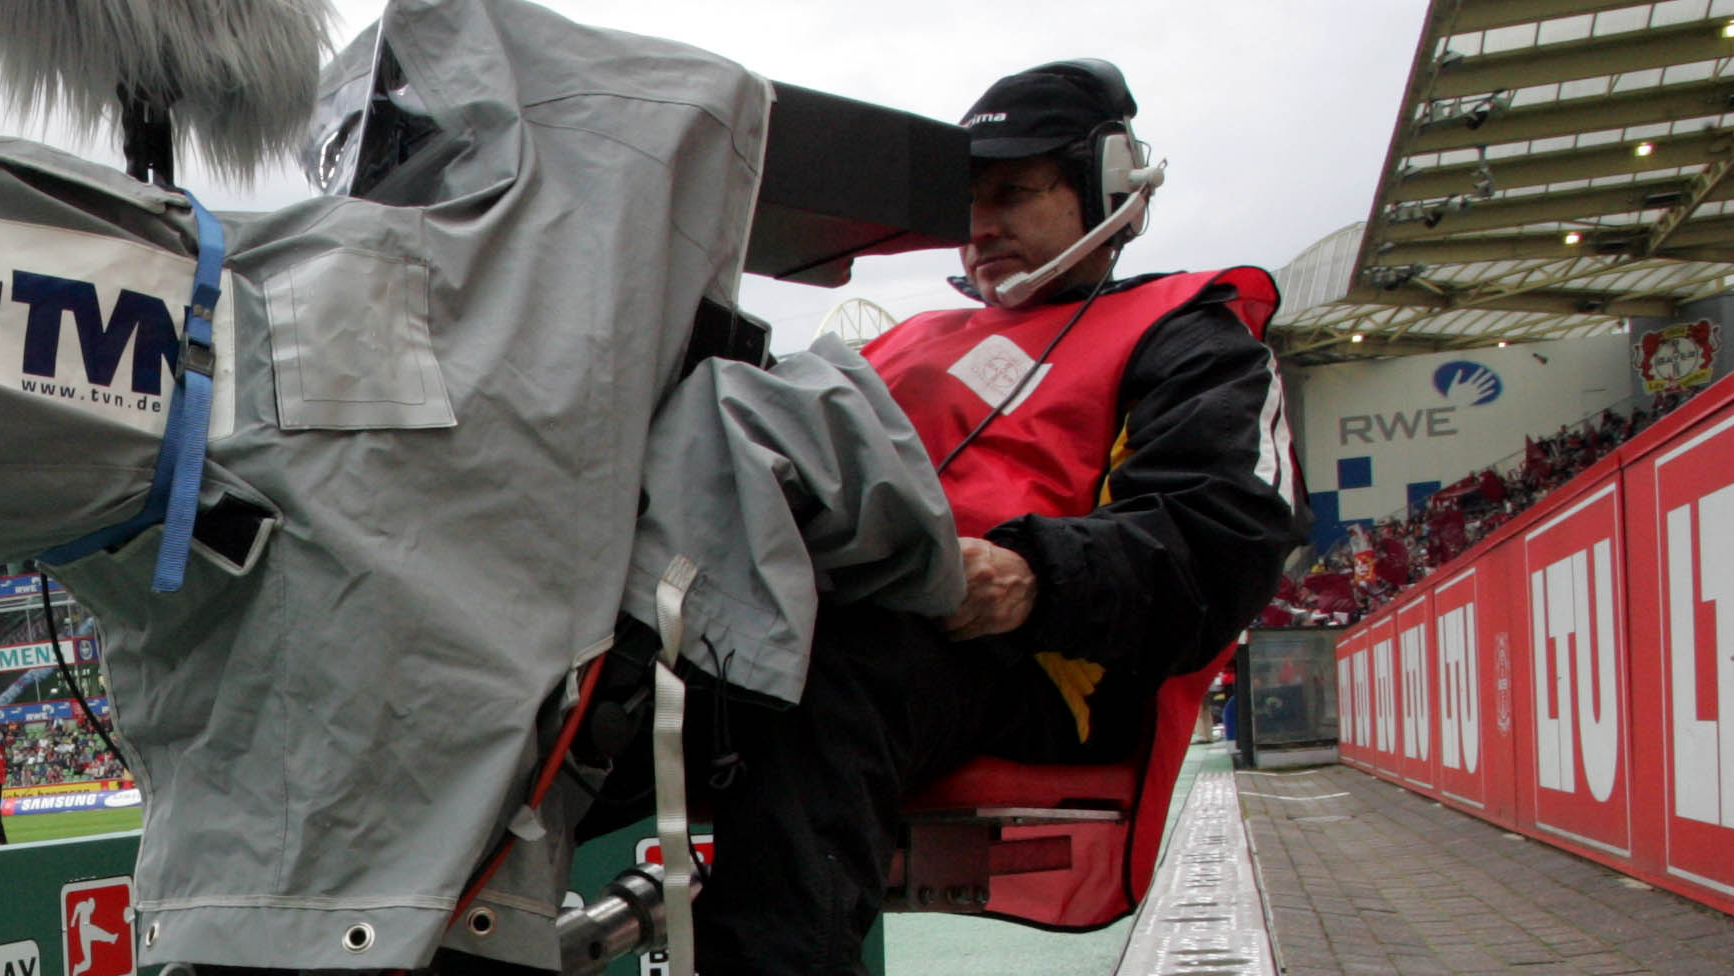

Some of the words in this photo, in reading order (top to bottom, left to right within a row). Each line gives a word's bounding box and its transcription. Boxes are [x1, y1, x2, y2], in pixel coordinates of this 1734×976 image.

[11, 269, 190, 396] TVN
[21, 378, 162, 413] www.tvn.de
[1339, 406, 1458, 446] RWE
[1373, 638, 1396, 755] LTU
[1399, 623, 1429, 762] LTU
[1437, 602, 1480, 774] LTU
[1531, 537, 1619, 803] LTU
[1666, 482, 1734, 829] LT
[21, 794, 97, 811] SAMSUNG
